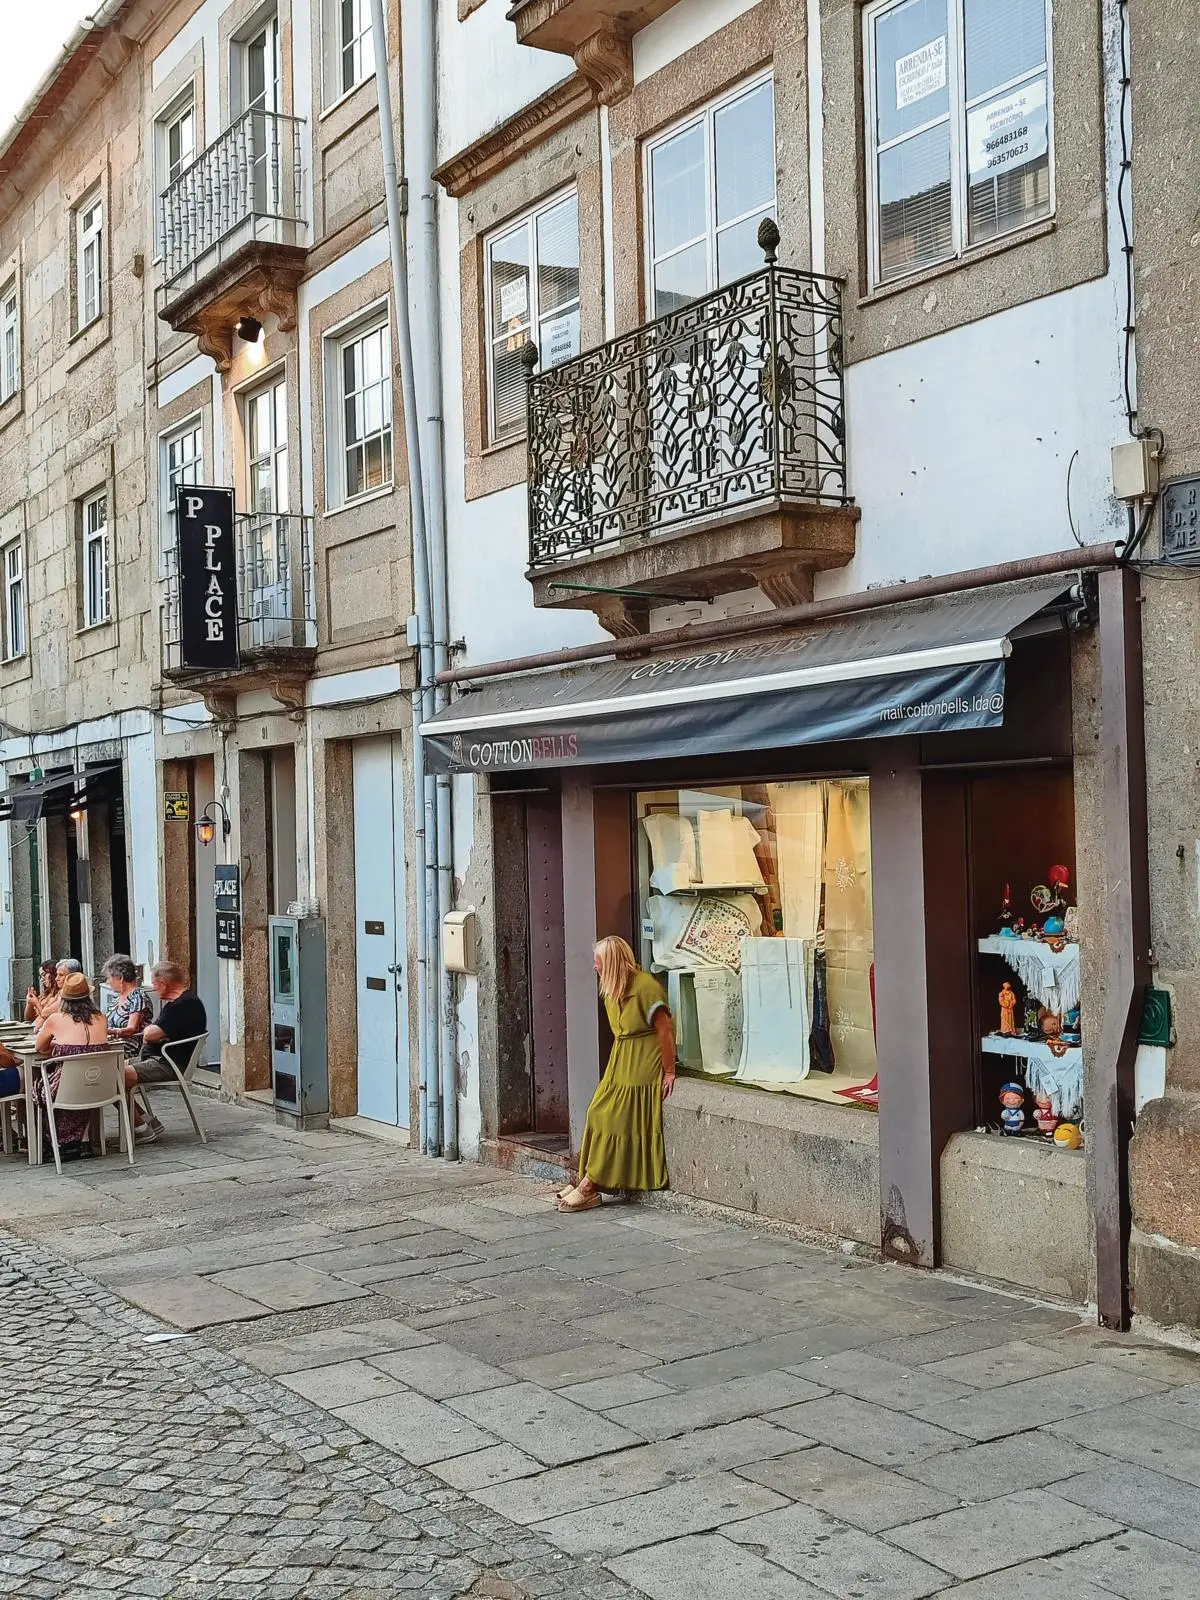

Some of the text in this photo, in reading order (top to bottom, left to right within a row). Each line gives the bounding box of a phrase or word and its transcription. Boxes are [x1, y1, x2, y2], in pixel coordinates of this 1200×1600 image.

[899, 41, 943, 76] ARRENDA-SE
[986, 104, 1014, 121] ARRENDA
[986, 126, 1028, 152] 966483168
[987, 142, 1029, 169] 963570623
[185, 496, 204, 519] P
[204, 524, 224, 642] PLACE
